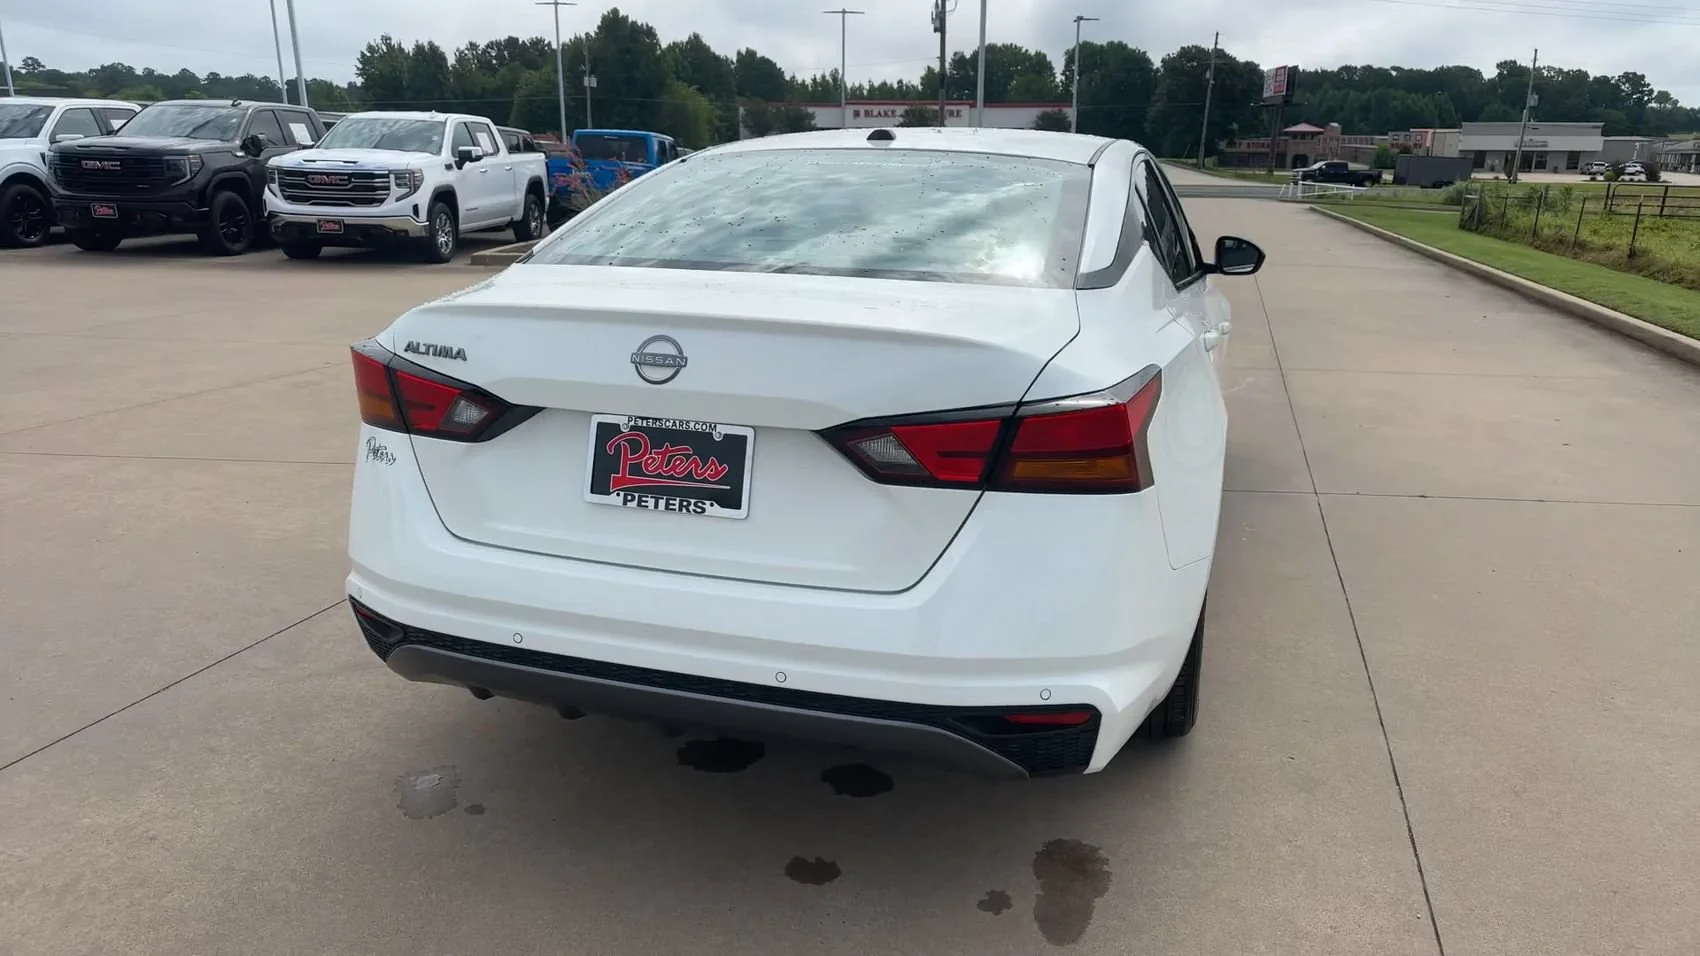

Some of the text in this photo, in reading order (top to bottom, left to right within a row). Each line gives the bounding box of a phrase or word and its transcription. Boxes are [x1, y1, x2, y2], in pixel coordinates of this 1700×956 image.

[863, 109, 896, 118] BLAKE
[81, 160, 121, 170] GMC
[307, 174, 349, 185] GMC
[404, 340, 468, 361] ALTIMA
[632, 354, 686, 366] NISSAN
[627, 416, 717, 433] PETERSCARS.COM
[365, 435, 397, 466] Peters
[606, 431, 730, 490] Peters
[622, 492, 707, 514] PETERS
